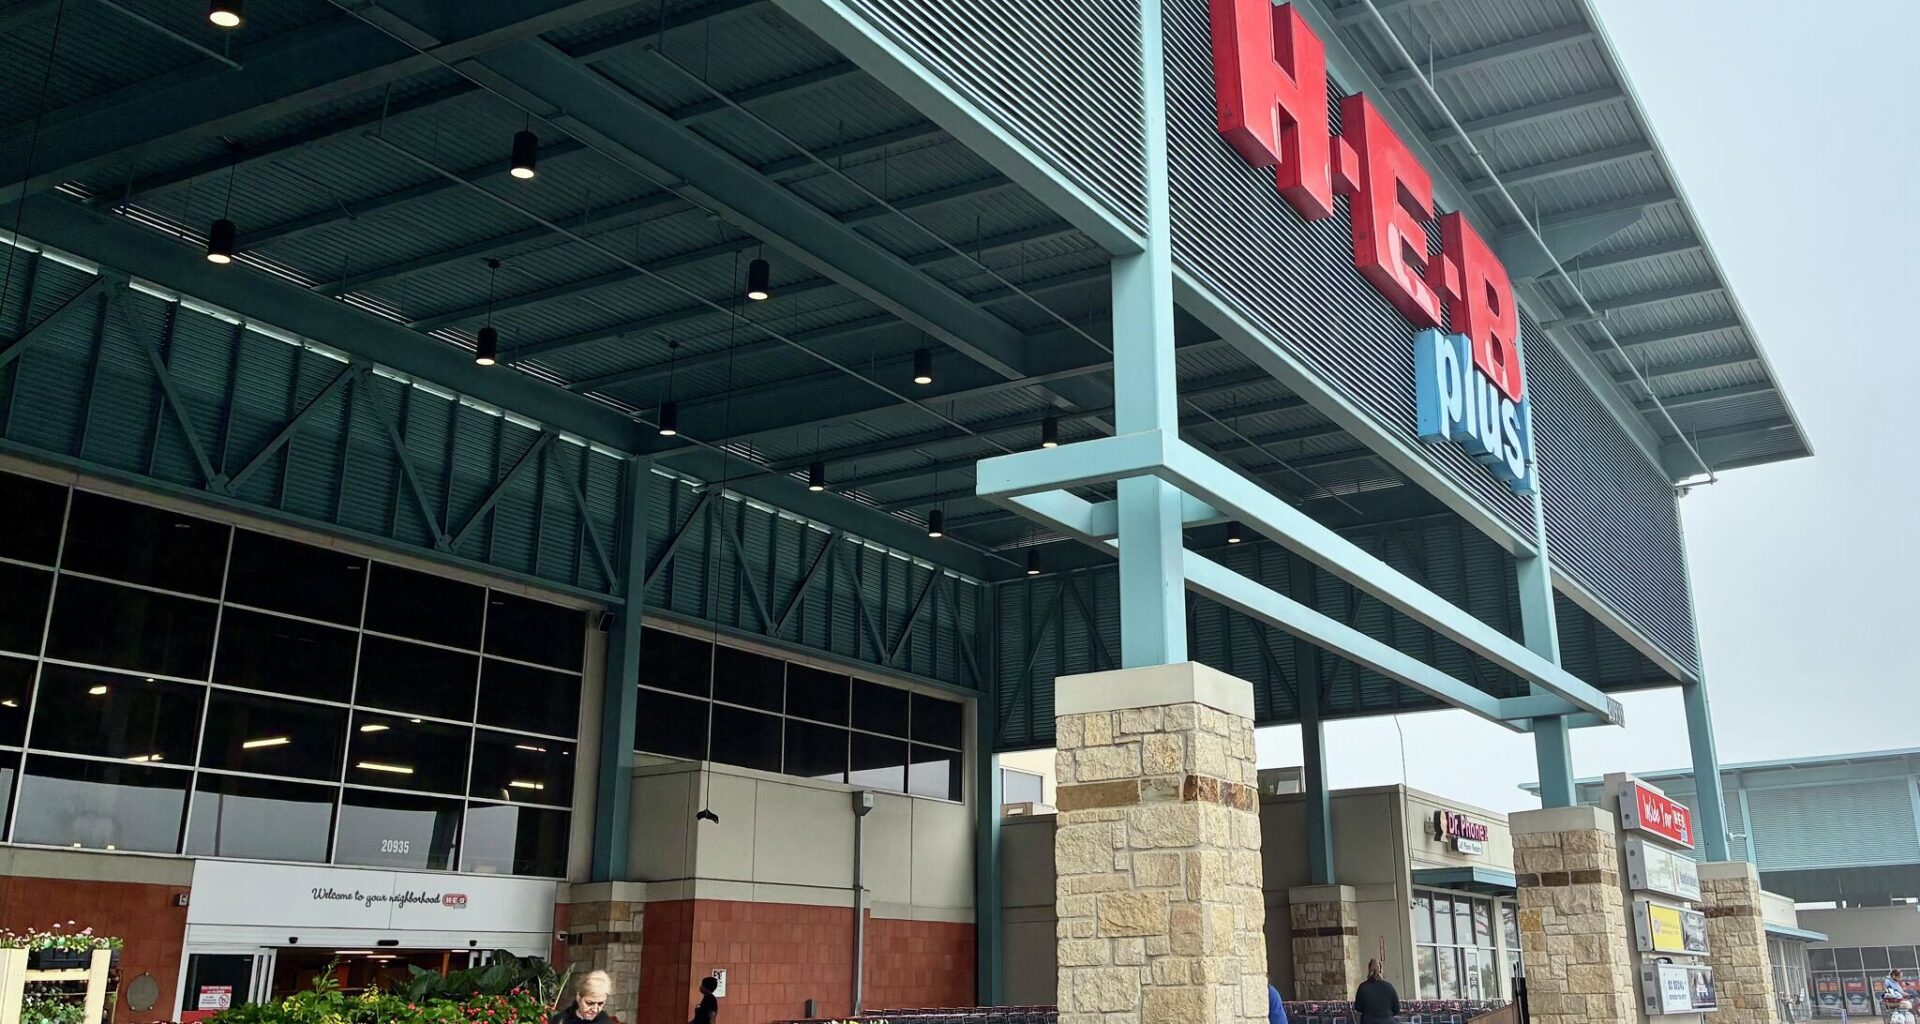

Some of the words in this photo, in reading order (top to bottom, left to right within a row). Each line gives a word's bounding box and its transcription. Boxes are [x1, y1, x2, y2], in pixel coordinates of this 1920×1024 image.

[1447, 811, 1460, 837] Dr.
[381, 839, 410, 854] 20935
[311, 888, 353, 900] Welcome
[354, 890, 364, 901] to
[366, 893, 388, 908] your
[389, 890, 441, 908] neighborhood
